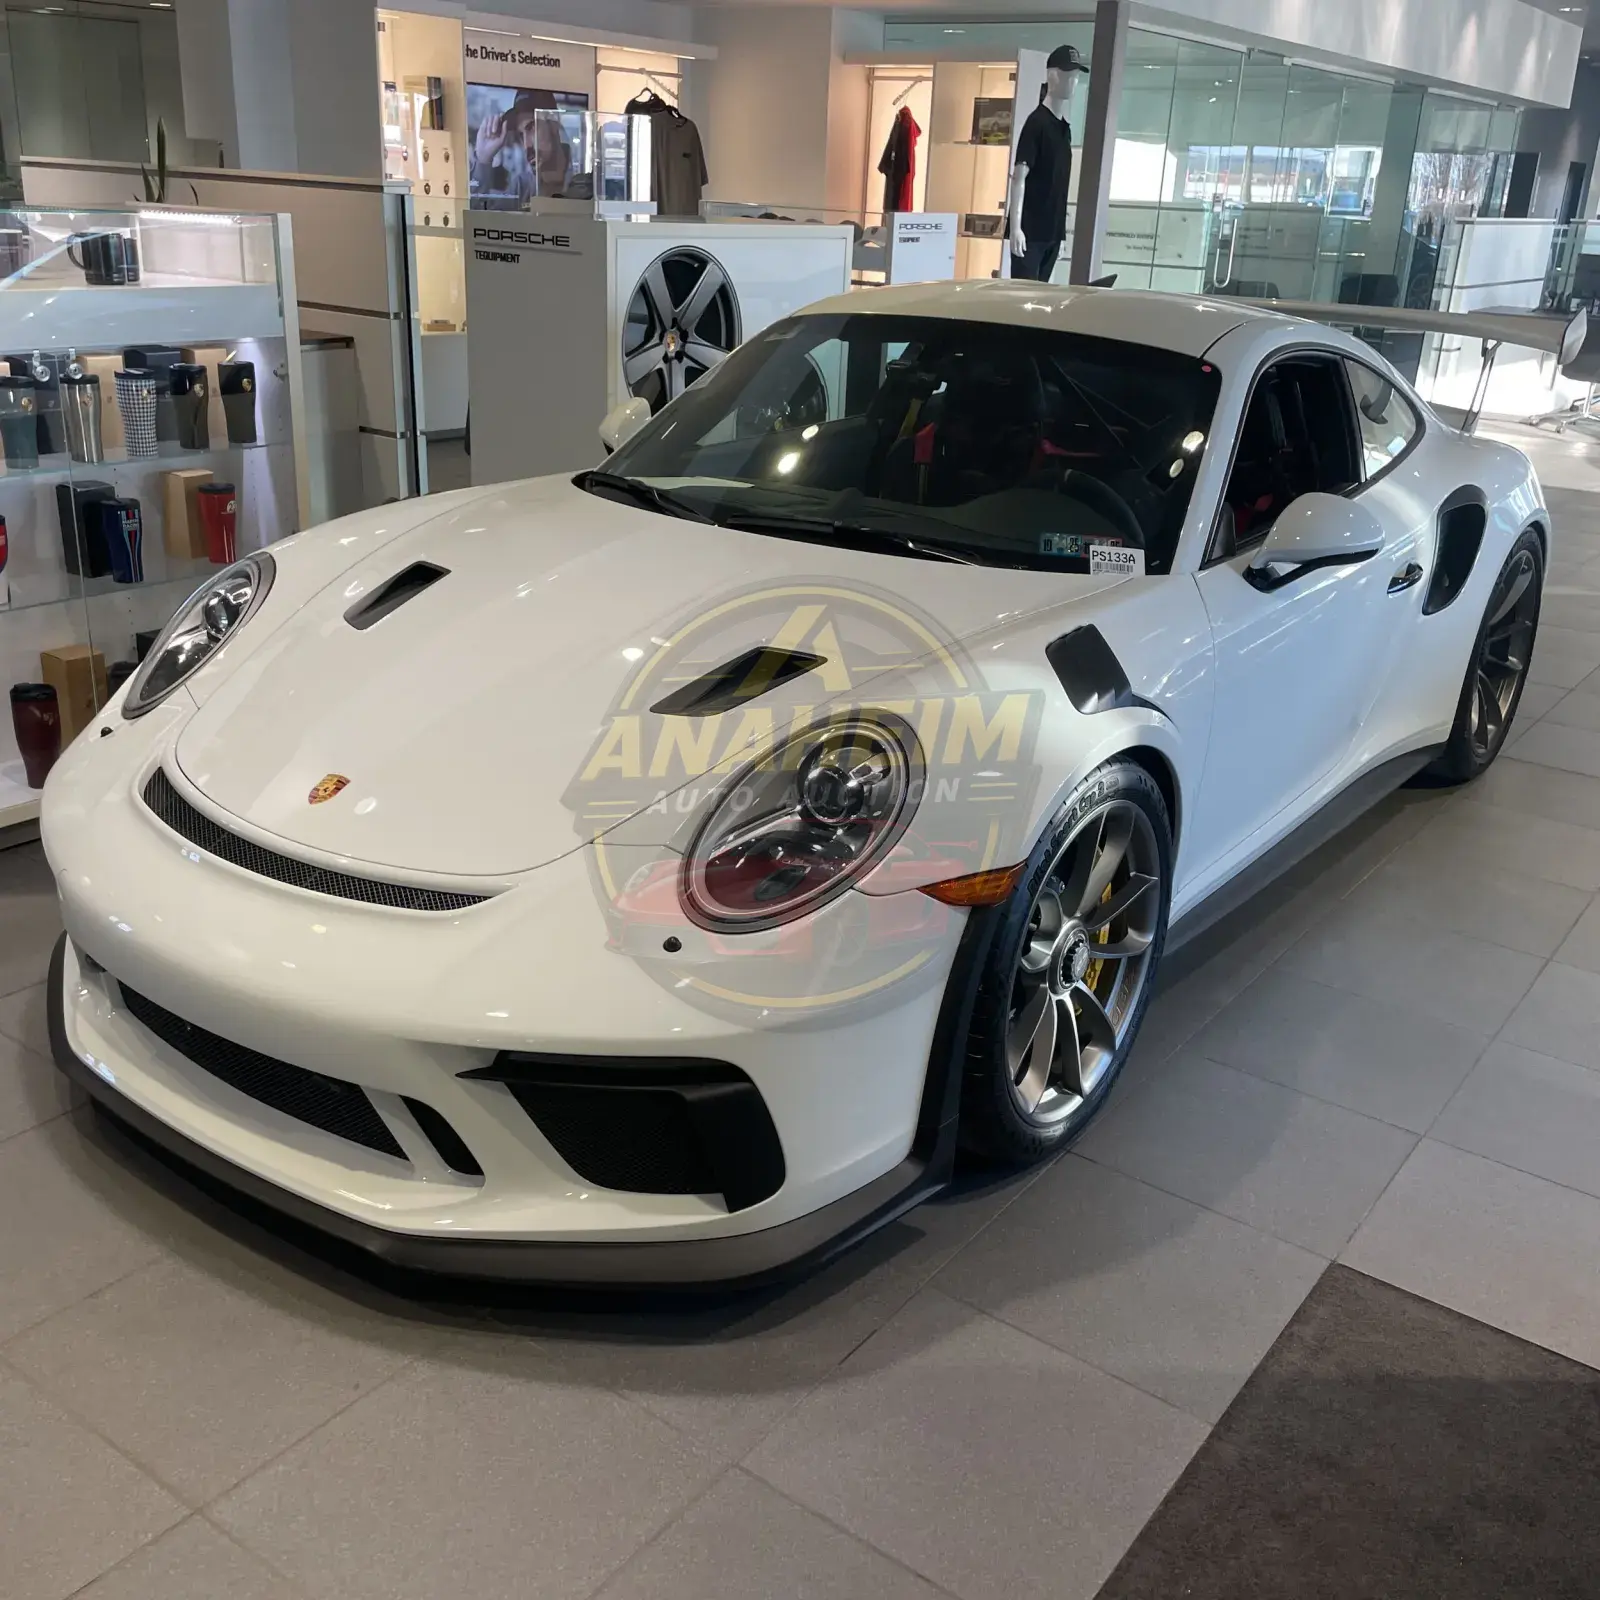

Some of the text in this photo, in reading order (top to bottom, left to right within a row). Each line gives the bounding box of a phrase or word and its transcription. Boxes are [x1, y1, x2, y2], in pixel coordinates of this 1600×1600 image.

[465, 44, 561, 68] he Driver's Selection
[474, 228, 570, 247] PORSCHE
[474, 249, 520, 264] TEQUIPMENT
[1092, 550, 1136, 565] PS133A
